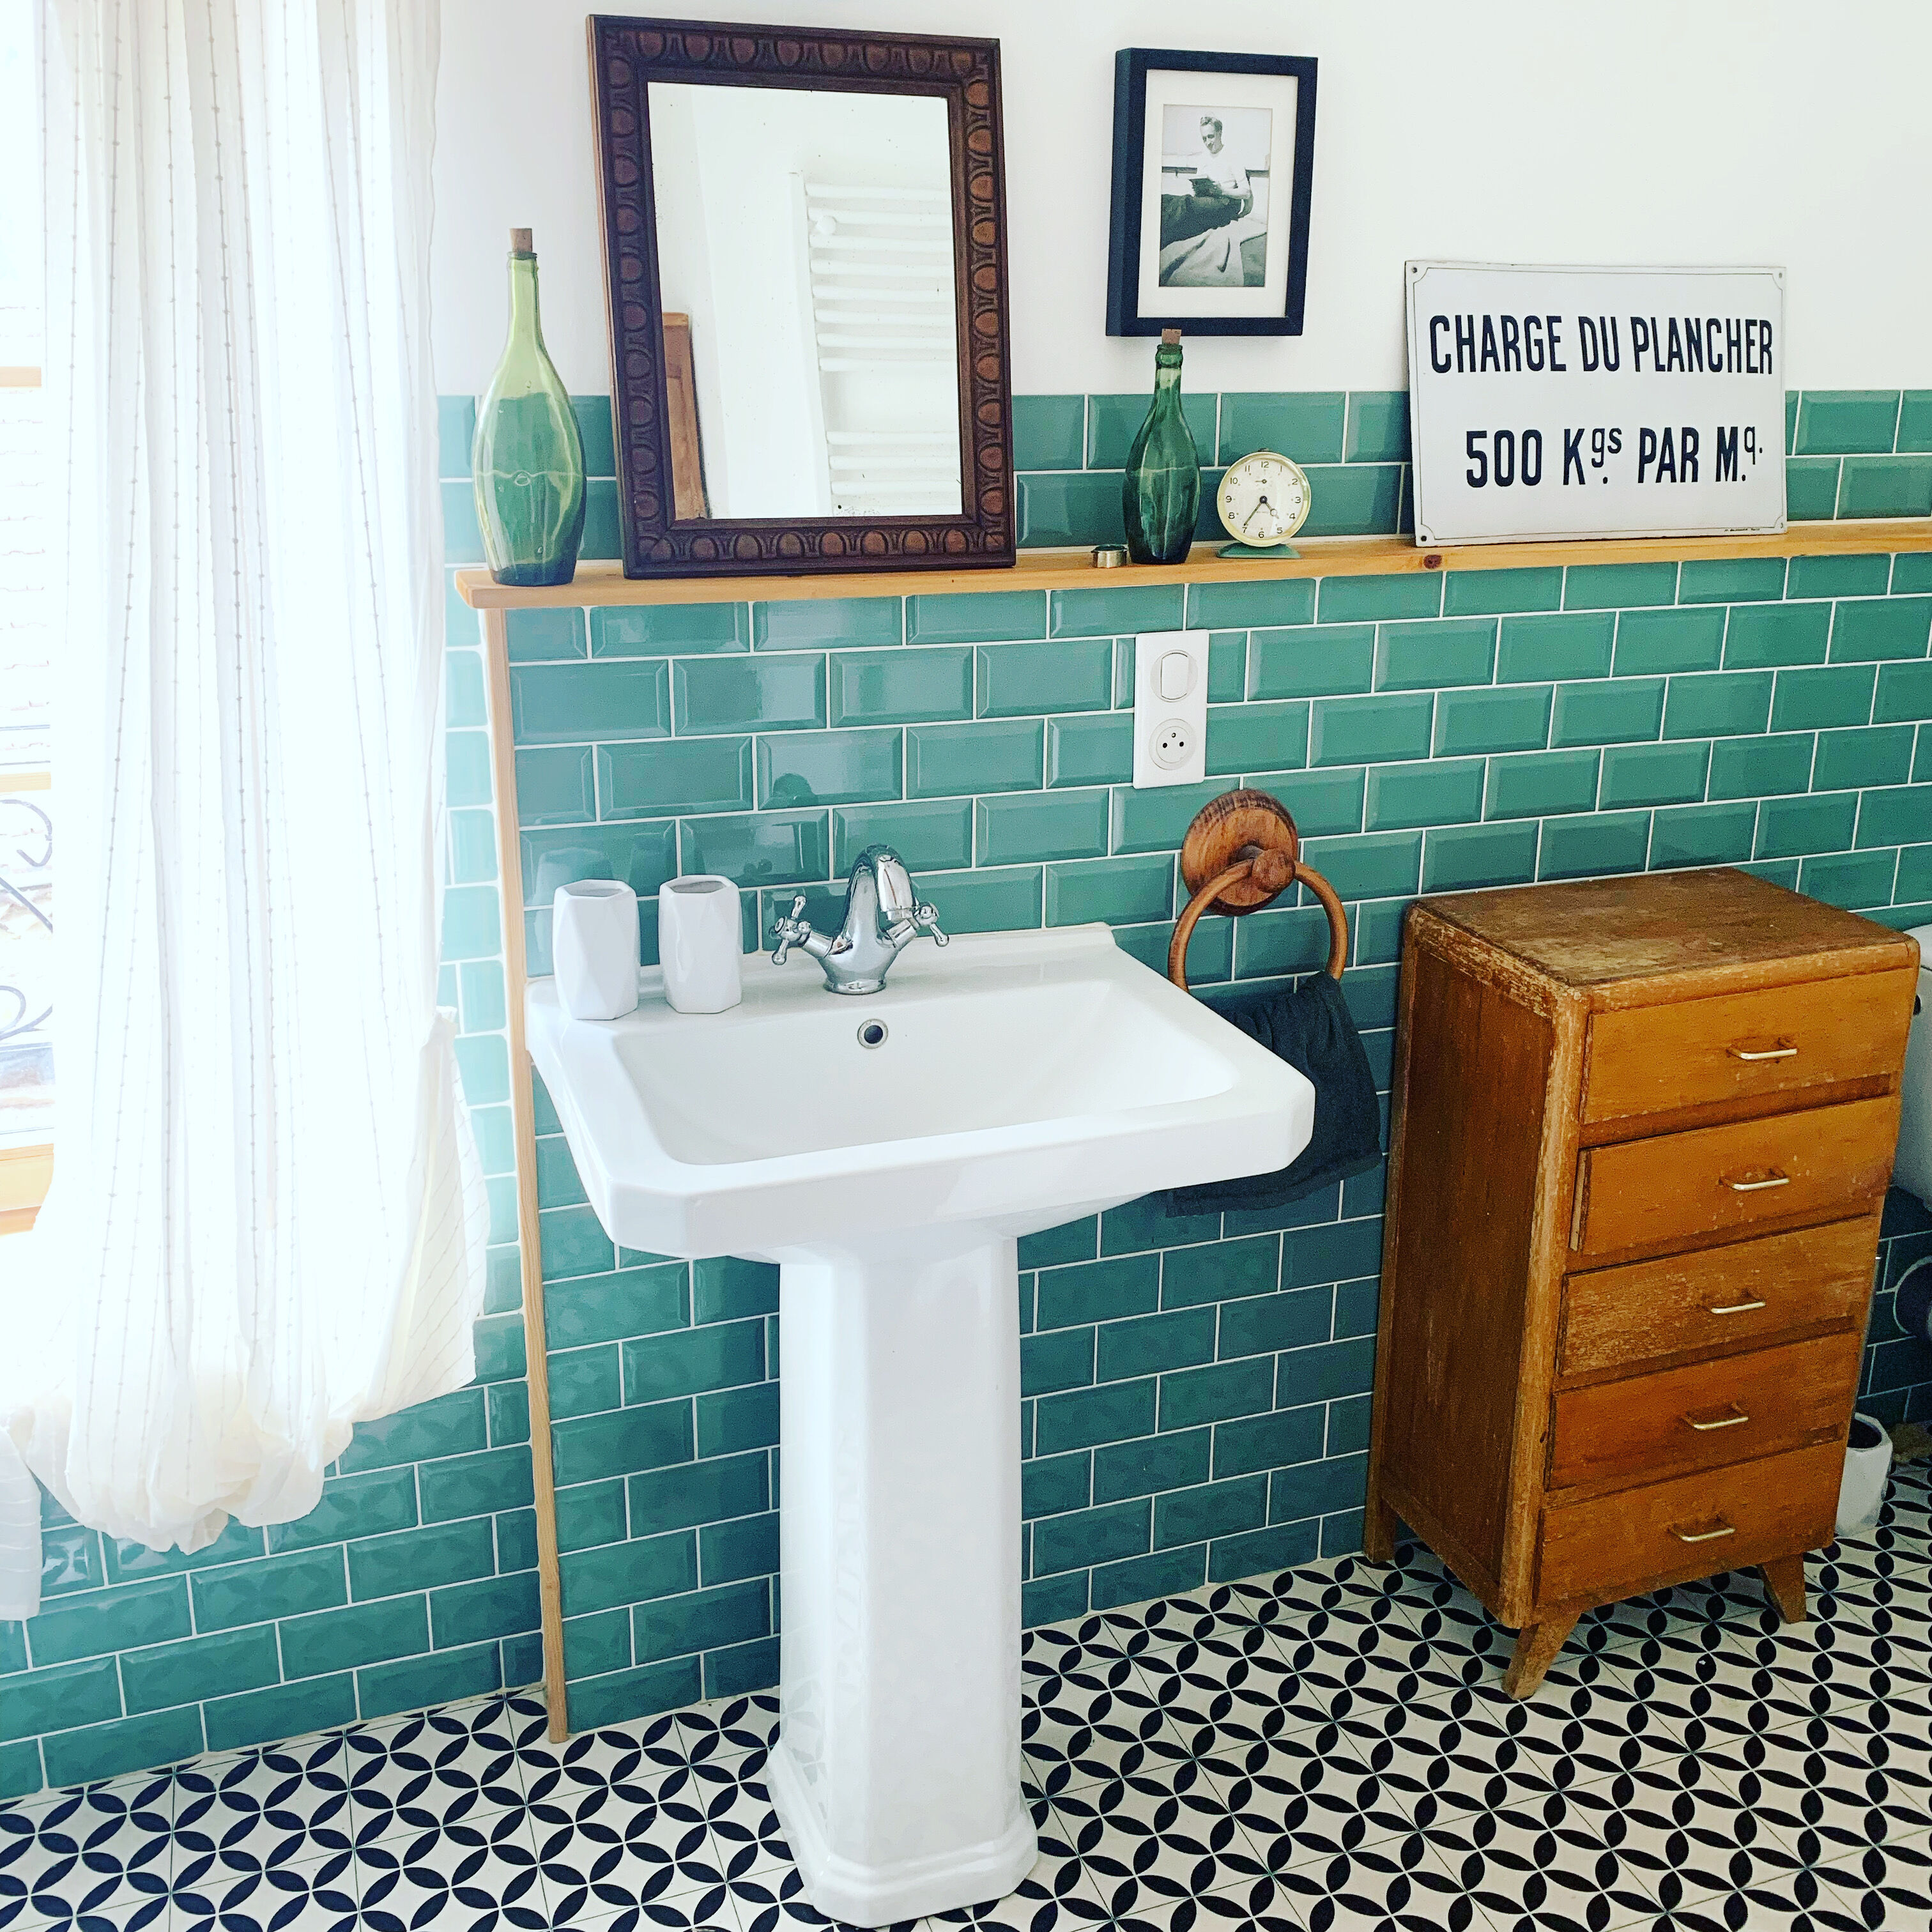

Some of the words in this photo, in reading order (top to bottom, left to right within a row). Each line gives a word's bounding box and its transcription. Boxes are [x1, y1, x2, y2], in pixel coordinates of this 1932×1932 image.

[1429, 314, 1567, 374] CHARGE
[1577, 316, 1620, 372] DU
[1630, 316, 1772, 375] PLANCHER
[1466, 429, 1542, 488] 500
[1637, 427, 1699, 484] PAR
